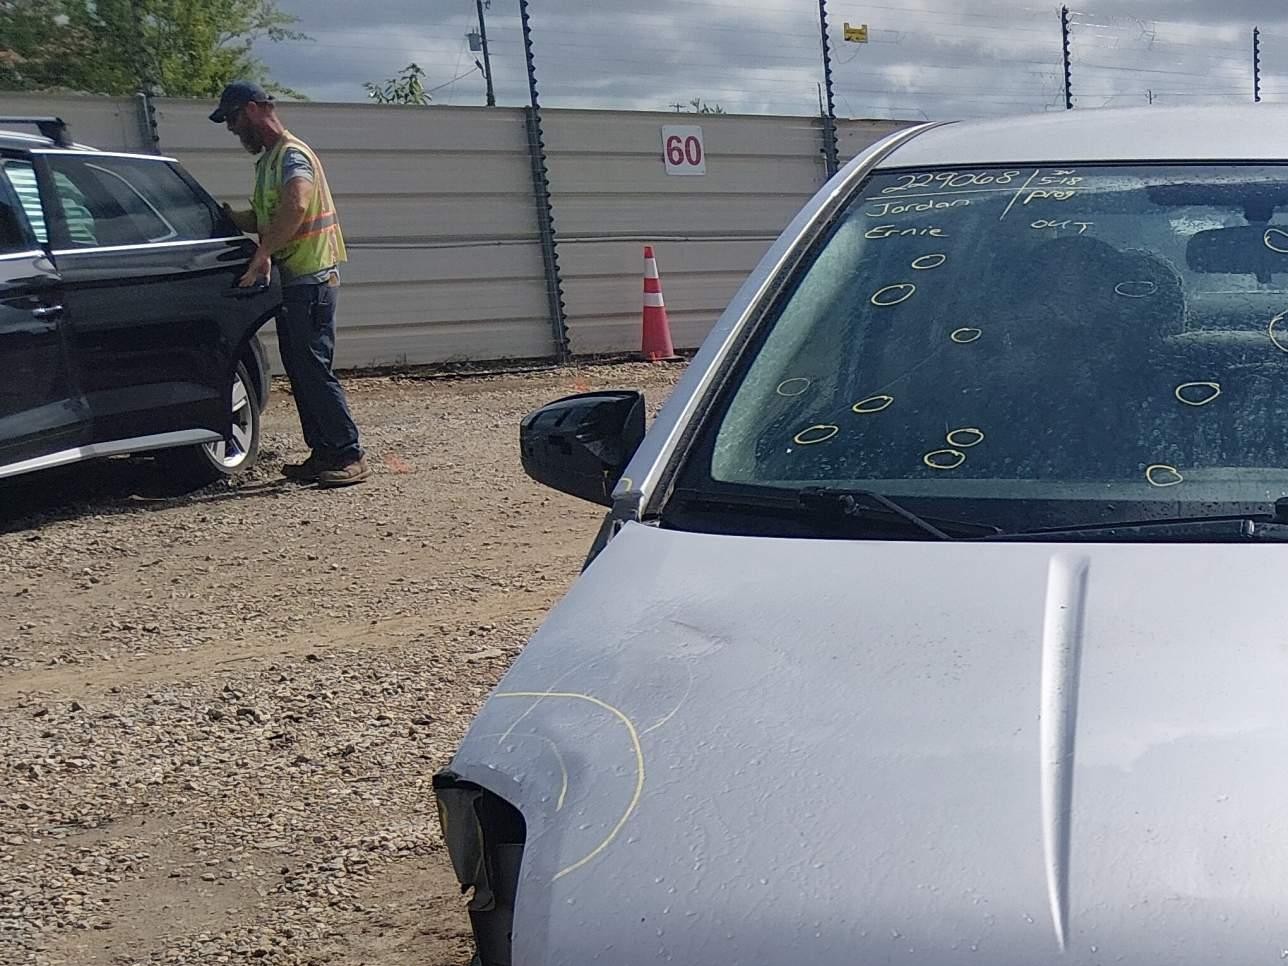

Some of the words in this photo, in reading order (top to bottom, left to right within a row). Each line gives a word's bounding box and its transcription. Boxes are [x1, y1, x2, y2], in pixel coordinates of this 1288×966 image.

[666, 135, 702, 166] 60
[881, 169, 1021, 193] 229068
[866, 199, 971, 217] Jordan
[864, 225, 950, 240] Ernie
